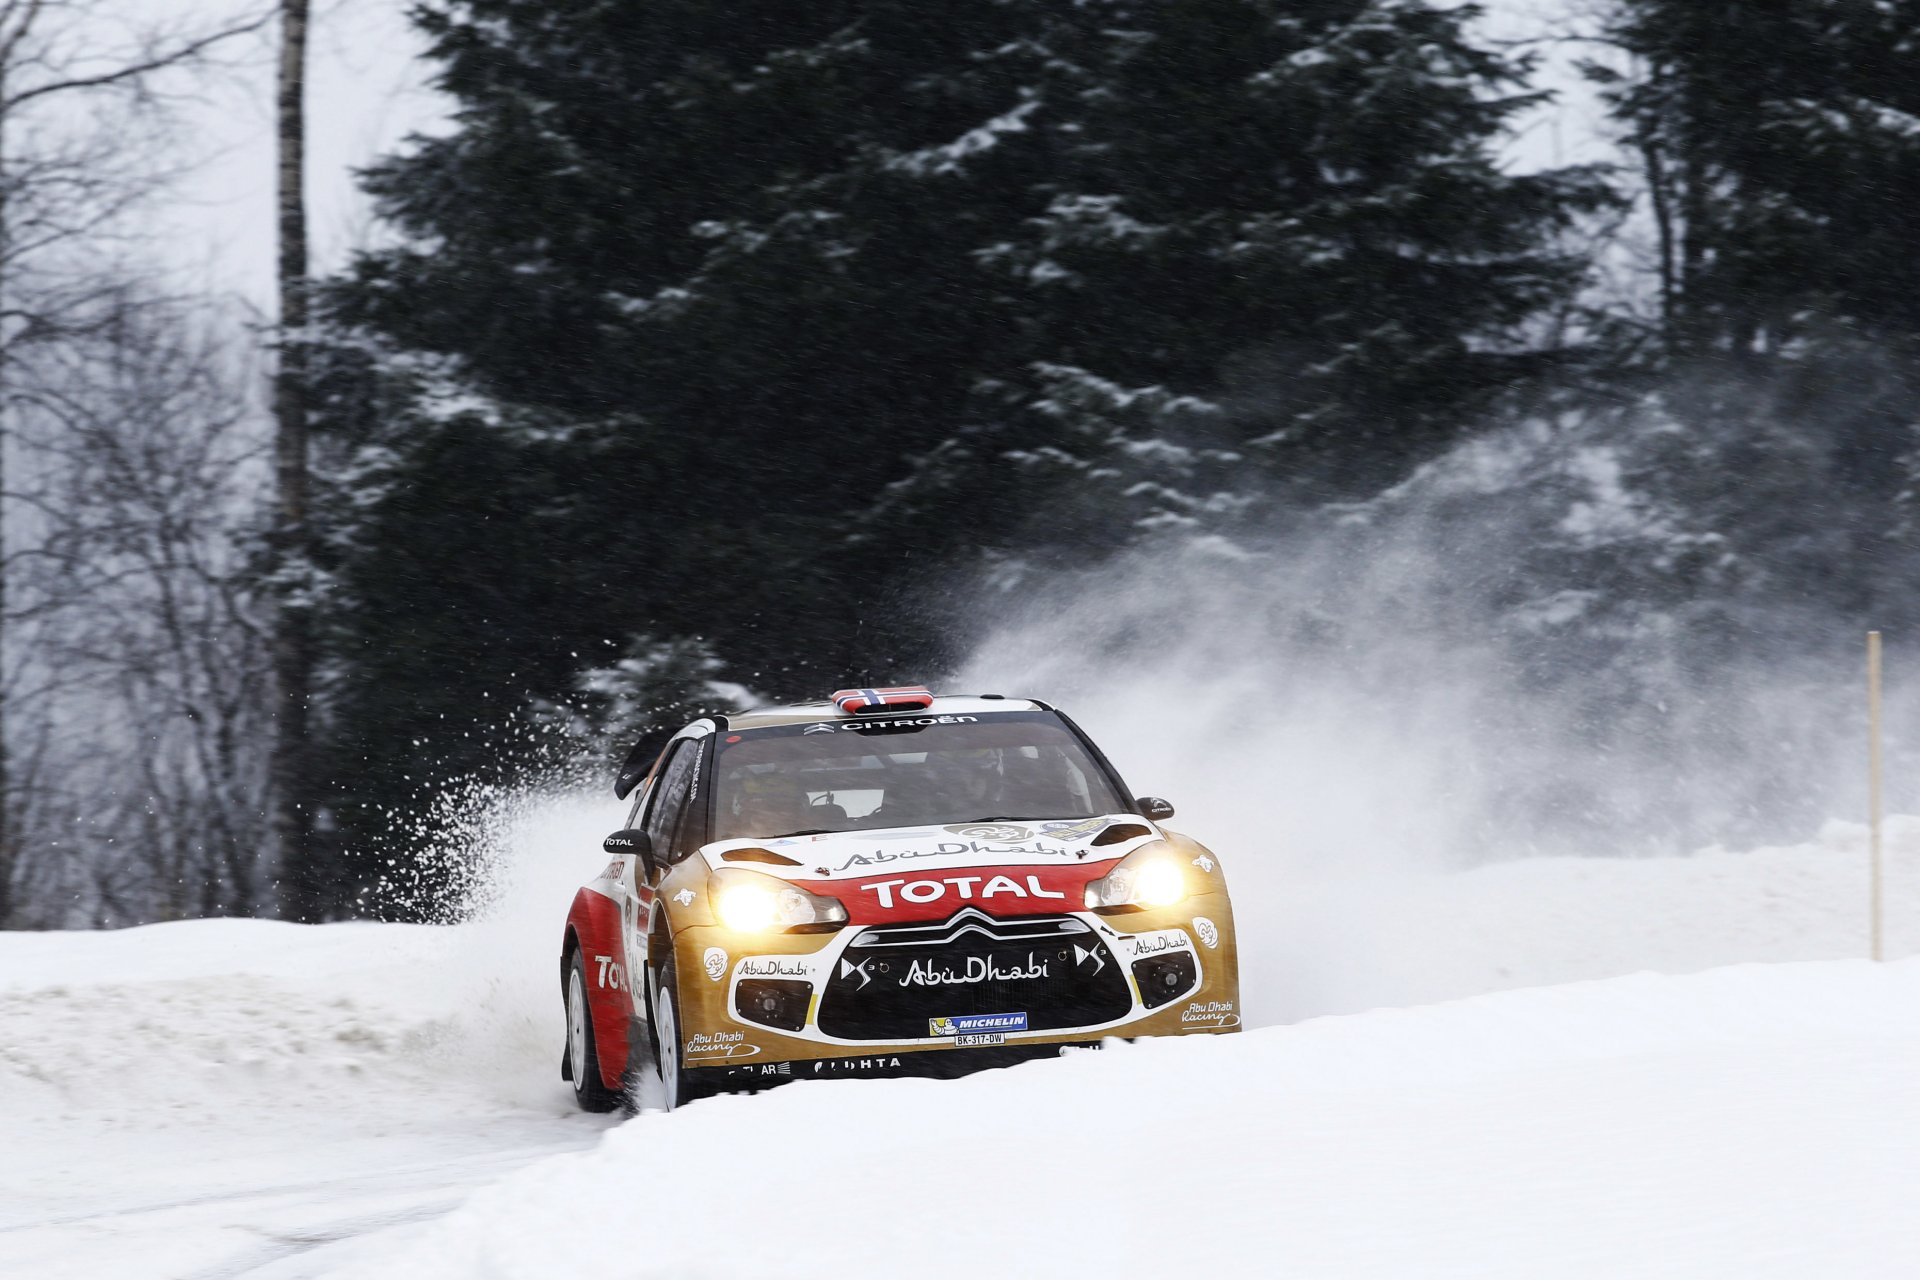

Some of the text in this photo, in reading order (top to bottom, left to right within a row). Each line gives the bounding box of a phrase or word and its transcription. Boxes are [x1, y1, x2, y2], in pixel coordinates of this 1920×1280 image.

[605, 837, 634, 846] TOTAL
[860, 875, 1065, 909] TOTAL
[1188, 1001, 1233, 1013] Abu Dhabi
[959, 1016, 1025, 1029] MICHELIN
[1182, 1010, 1231, 1026] Racing
[693, 1031, 745, 1044] Abu Dhabi
[957, 1033, 1002, 1046] BK-317-DW
[687, 1042, 742, 1056] Racing
